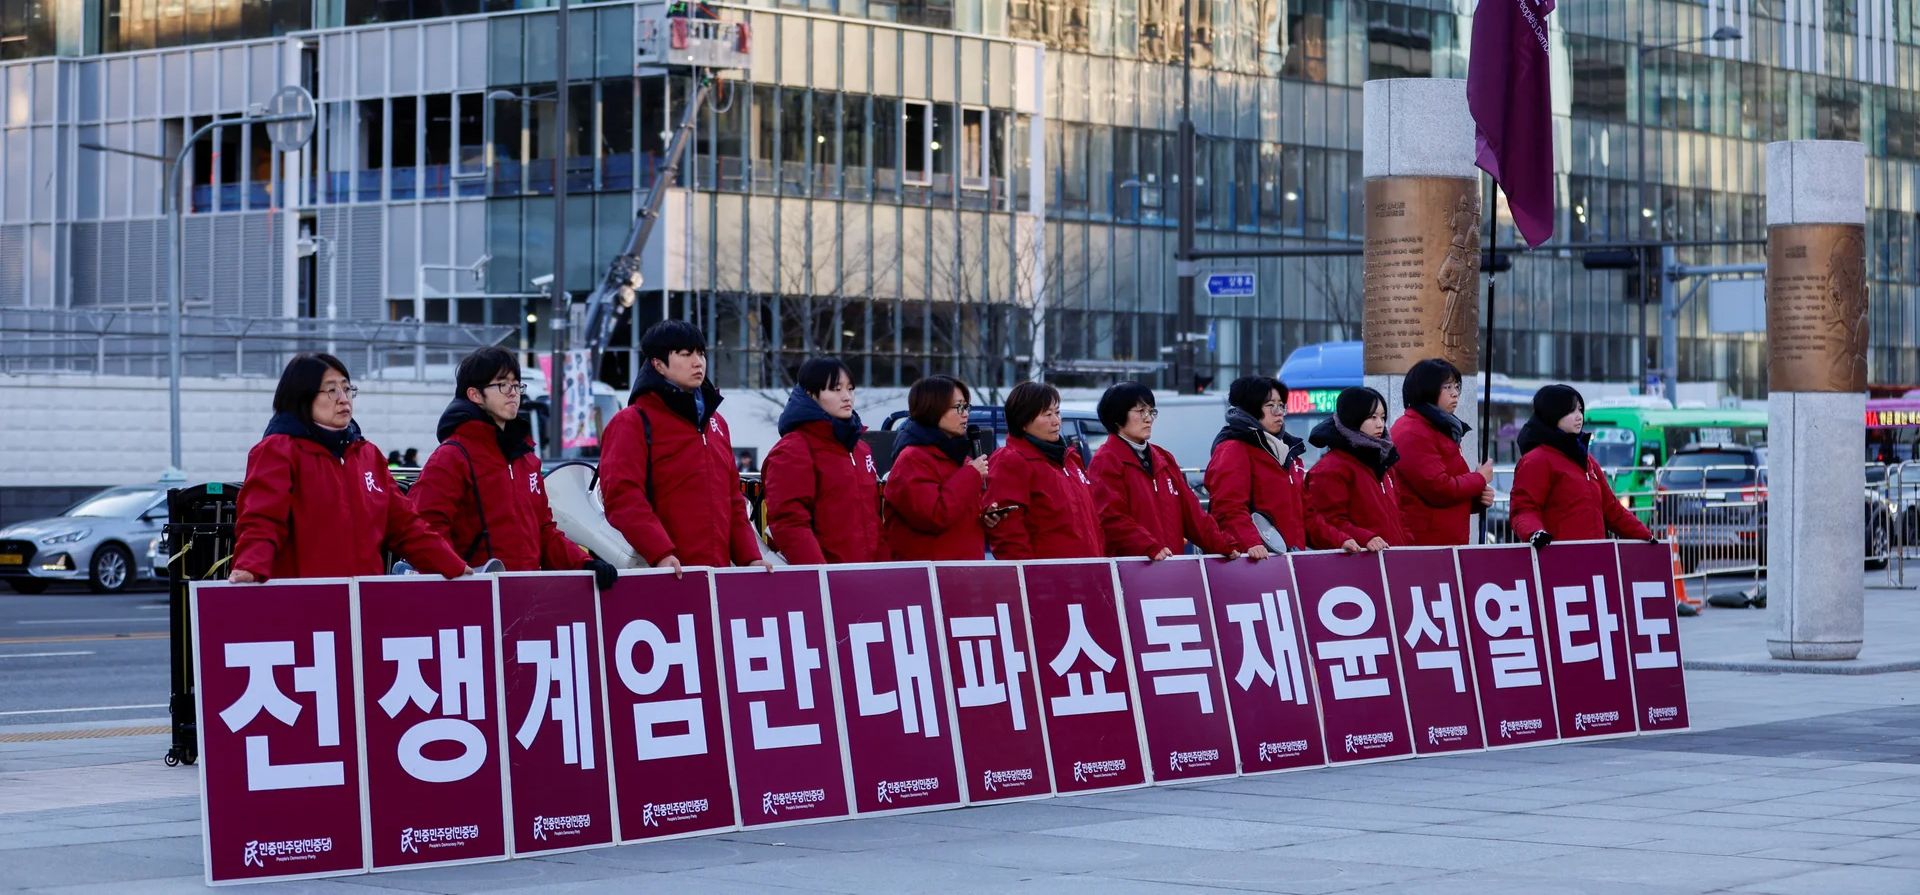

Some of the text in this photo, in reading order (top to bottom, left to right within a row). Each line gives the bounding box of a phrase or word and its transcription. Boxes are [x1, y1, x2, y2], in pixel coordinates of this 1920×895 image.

[1517, 0, 1538, 29] eople's
[364, 471, 383, 493] 民
[529, 472, 541, 495] 民
[219, 575, 1678, 791] 전 쟁 계 엄 반 대 파 쇼 독 재 윤 석 열 타 도
[1346, 734, 1357, 753] 民
[1429, 726, 1439, 745] 民
[1170, 751, 1182, 771] 民
[1259, 742, 1271, 761] 民
[984, 768, 1032, 791] 民 민중민주당(민중당)
[1074, 759, 1126, 782] 民 민중민주당(민중당)
[763, 789, 824, 815] 民 민중민주당(민중당)
[878, 777, 938, 803] 民 민중민주당(민중당)
[643, 799, 708, 826] 民 민중민주당(민중당)
[402, 825, 478, 853] 民 민중민주당(민중당)
[534, 814, 590, 840] 民 민중민주당(민중당)
[244, 837, 331, 867] 民 민중민주당(민중당)
